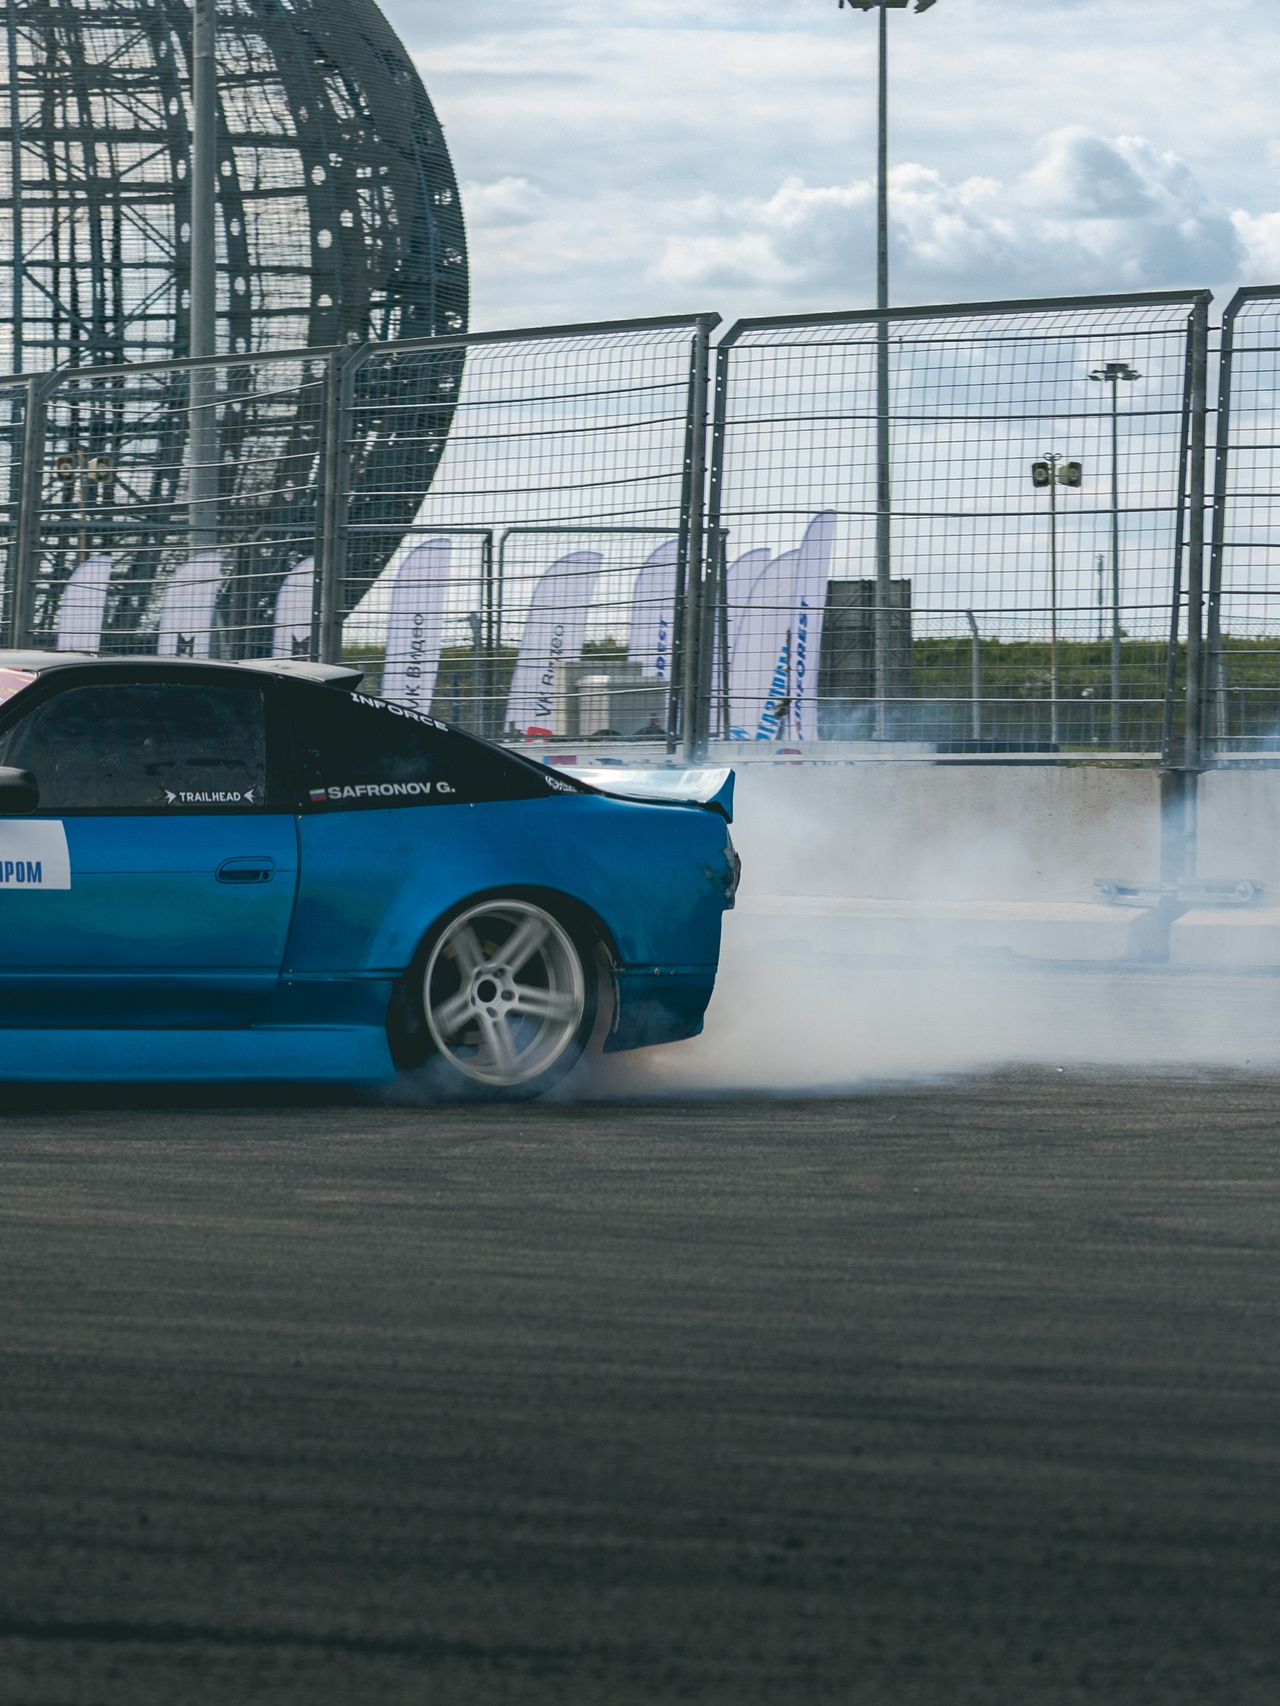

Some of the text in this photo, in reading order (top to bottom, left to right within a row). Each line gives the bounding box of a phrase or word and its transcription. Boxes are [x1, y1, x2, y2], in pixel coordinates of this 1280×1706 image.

[350, 692, 449, 732] INFORCE
[179, 791, 241, 802] TRAILHEAD
[327, 781, 456, 800] SAFRONOV G.
